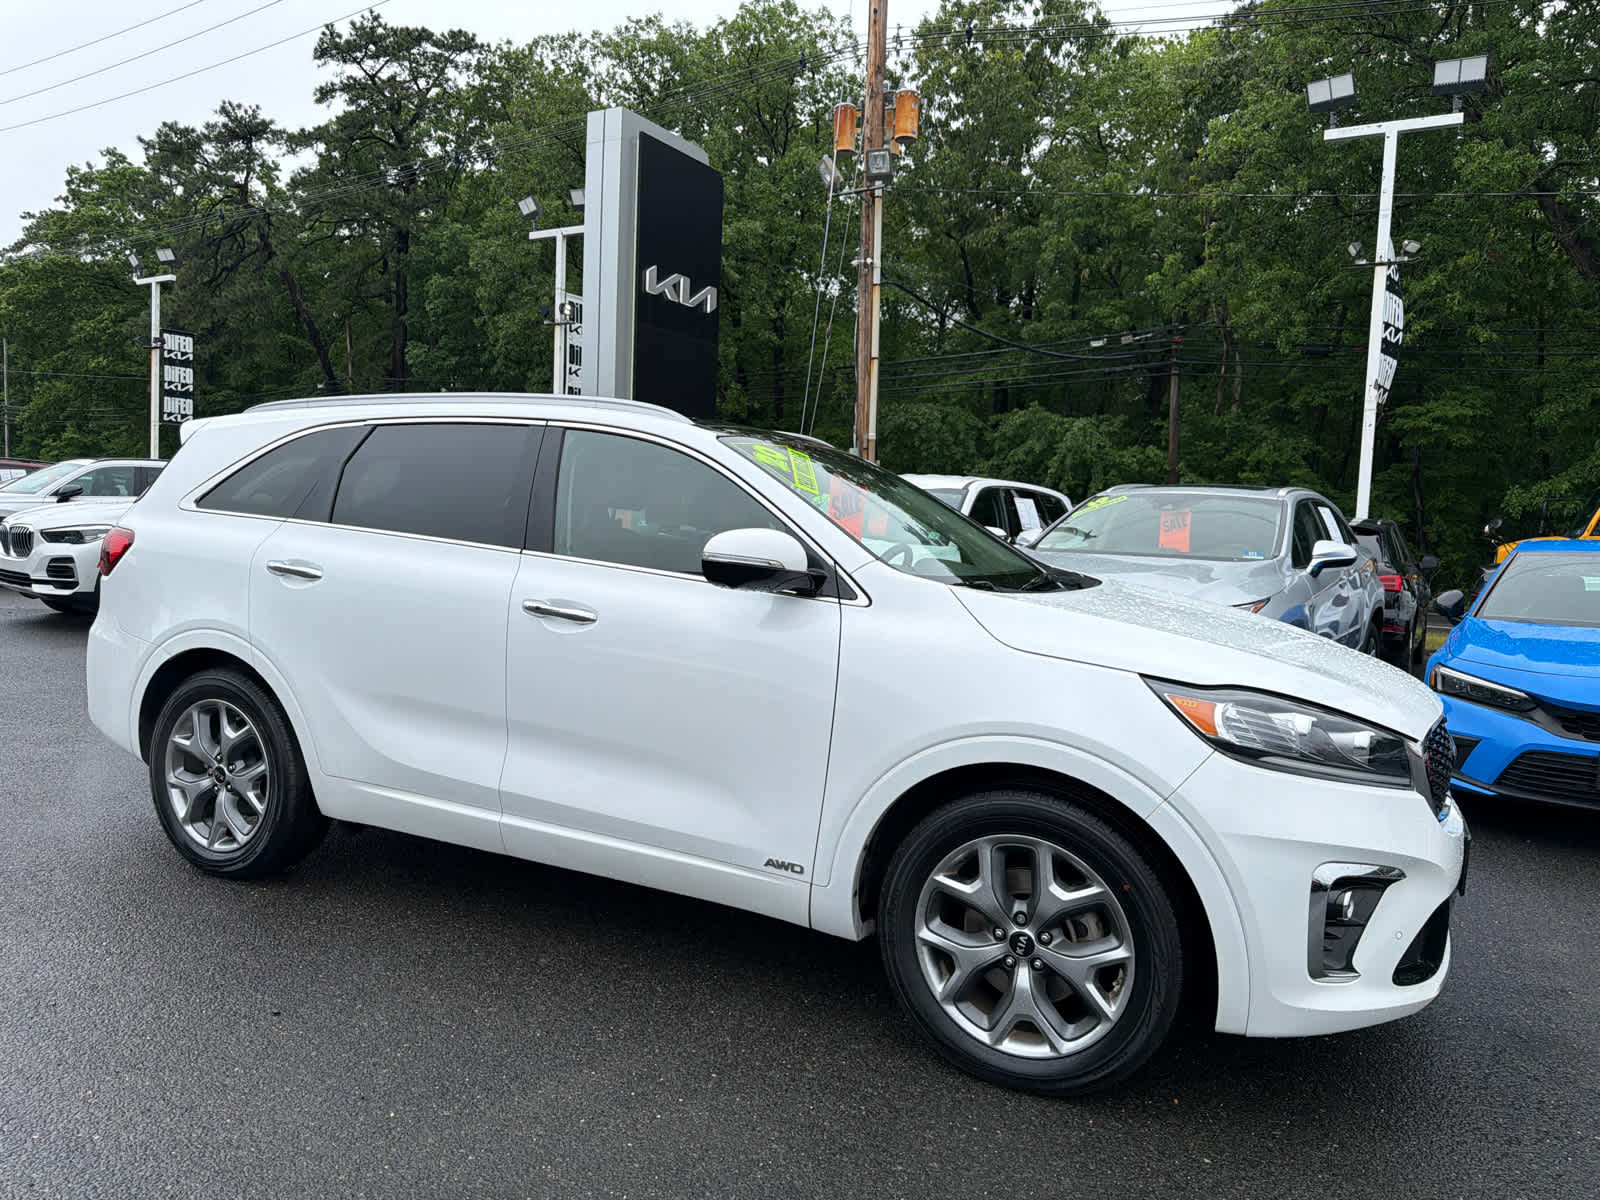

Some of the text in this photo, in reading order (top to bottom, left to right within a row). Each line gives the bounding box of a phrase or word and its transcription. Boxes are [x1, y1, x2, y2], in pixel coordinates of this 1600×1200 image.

[645, 265, 718, 314] KIA
[831, 494, 865, 521] SALE
[1163, 512, 1188, 533] SALE
[763, 857, 805, 875] AWD
[1015, 935, 1029, 956] KIA
